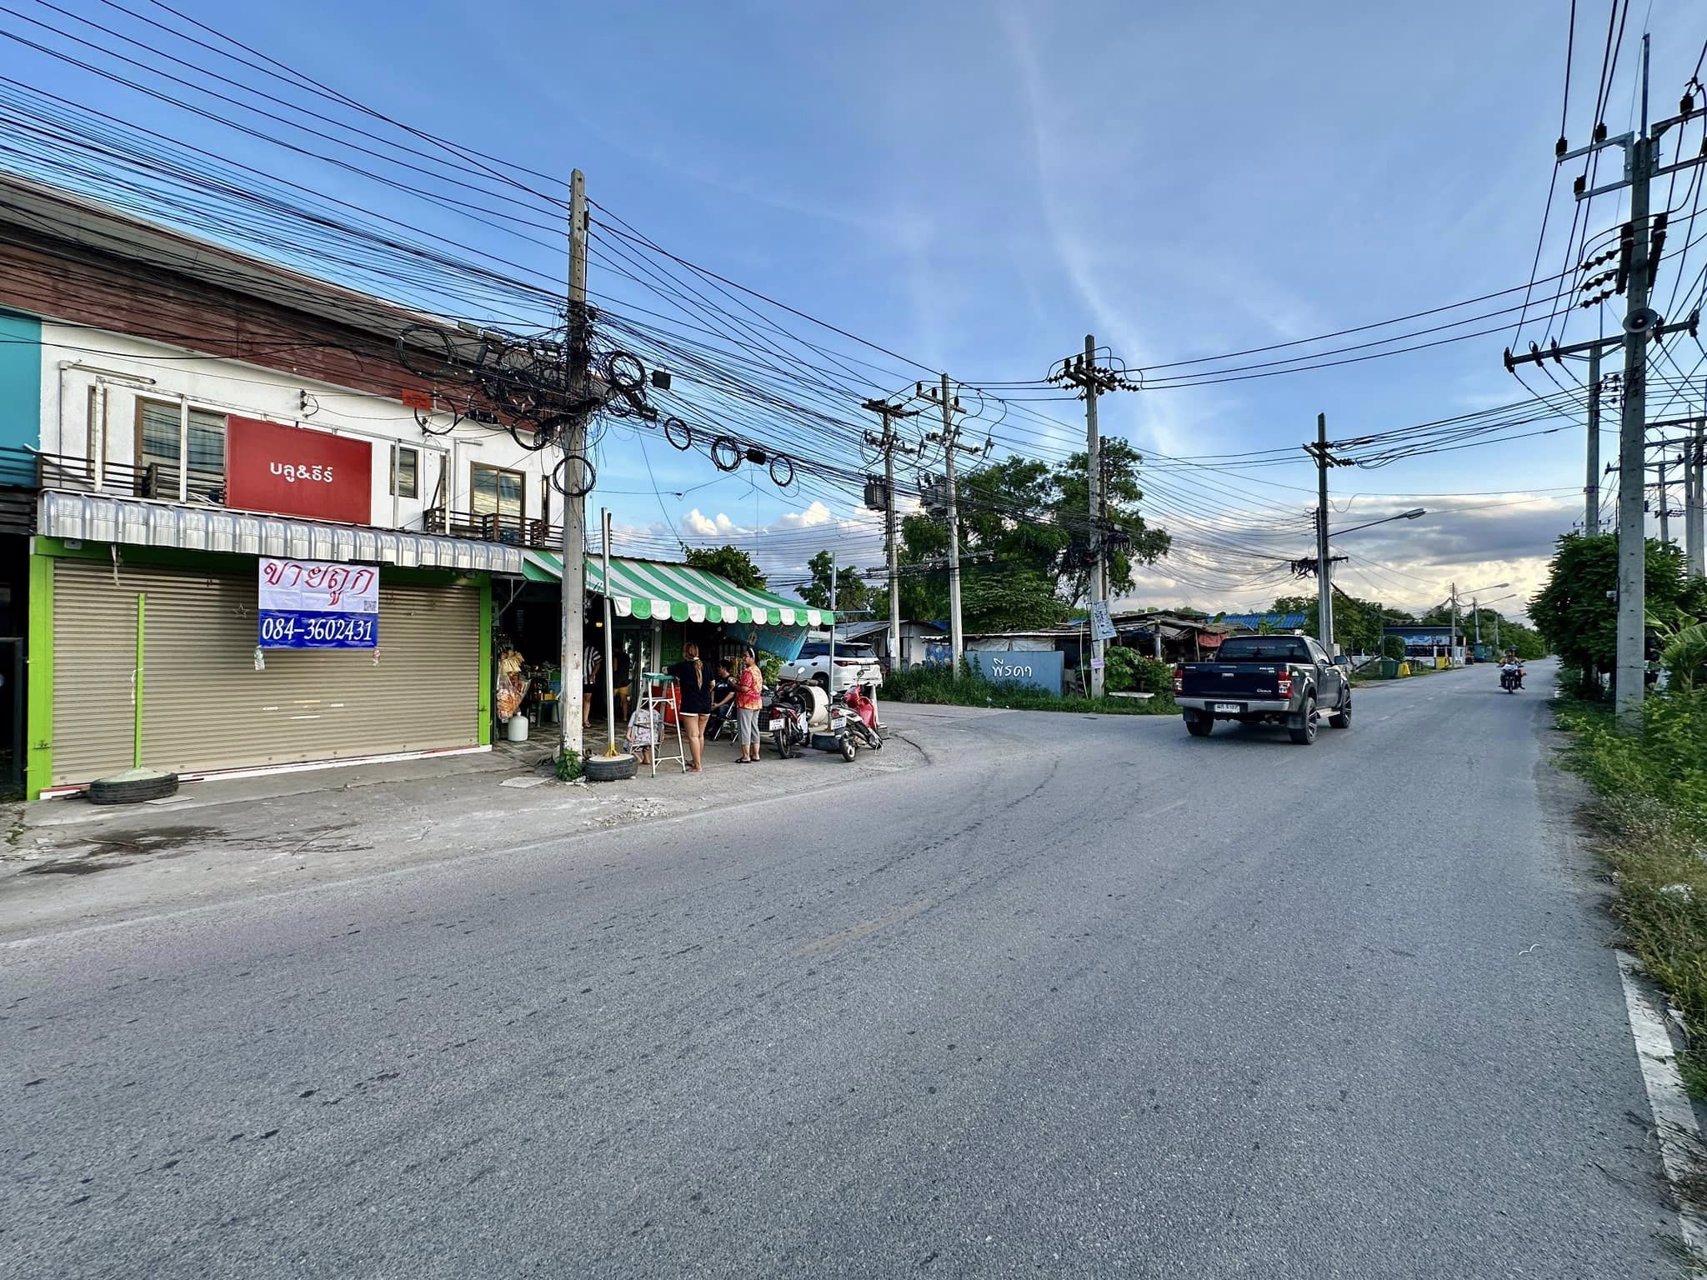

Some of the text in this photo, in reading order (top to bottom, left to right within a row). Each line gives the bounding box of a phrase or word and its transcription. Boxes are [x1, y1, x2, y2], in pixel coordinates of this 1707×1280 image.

[264, 561, 375, 607] ขายถูก
[262, 617, 373, 641] 084-3602431
